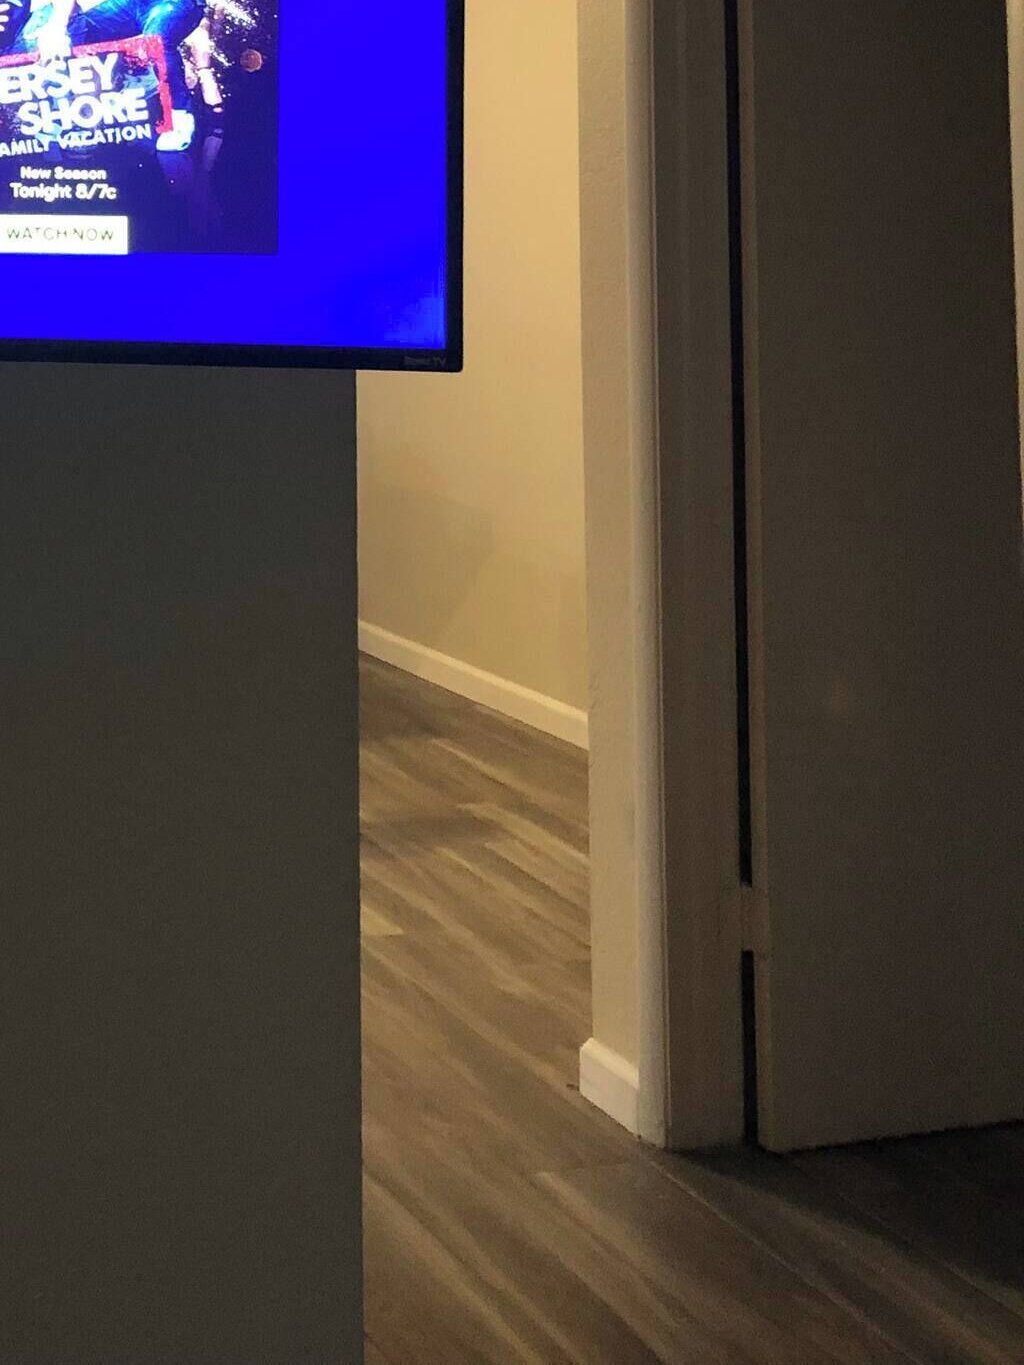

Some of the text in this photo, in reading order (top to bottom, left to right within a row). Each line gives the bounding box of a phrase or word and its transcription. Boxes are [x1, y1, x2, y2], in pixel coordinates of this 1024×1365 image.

[17, 87, 150, 135] SHORE
[57, 124, 152, 151] VACATION
[20, 165, 107, 181] New Season
[9, 182, 73, 203] Tonight
[6, 226, 115, 242] WATCH NOW
